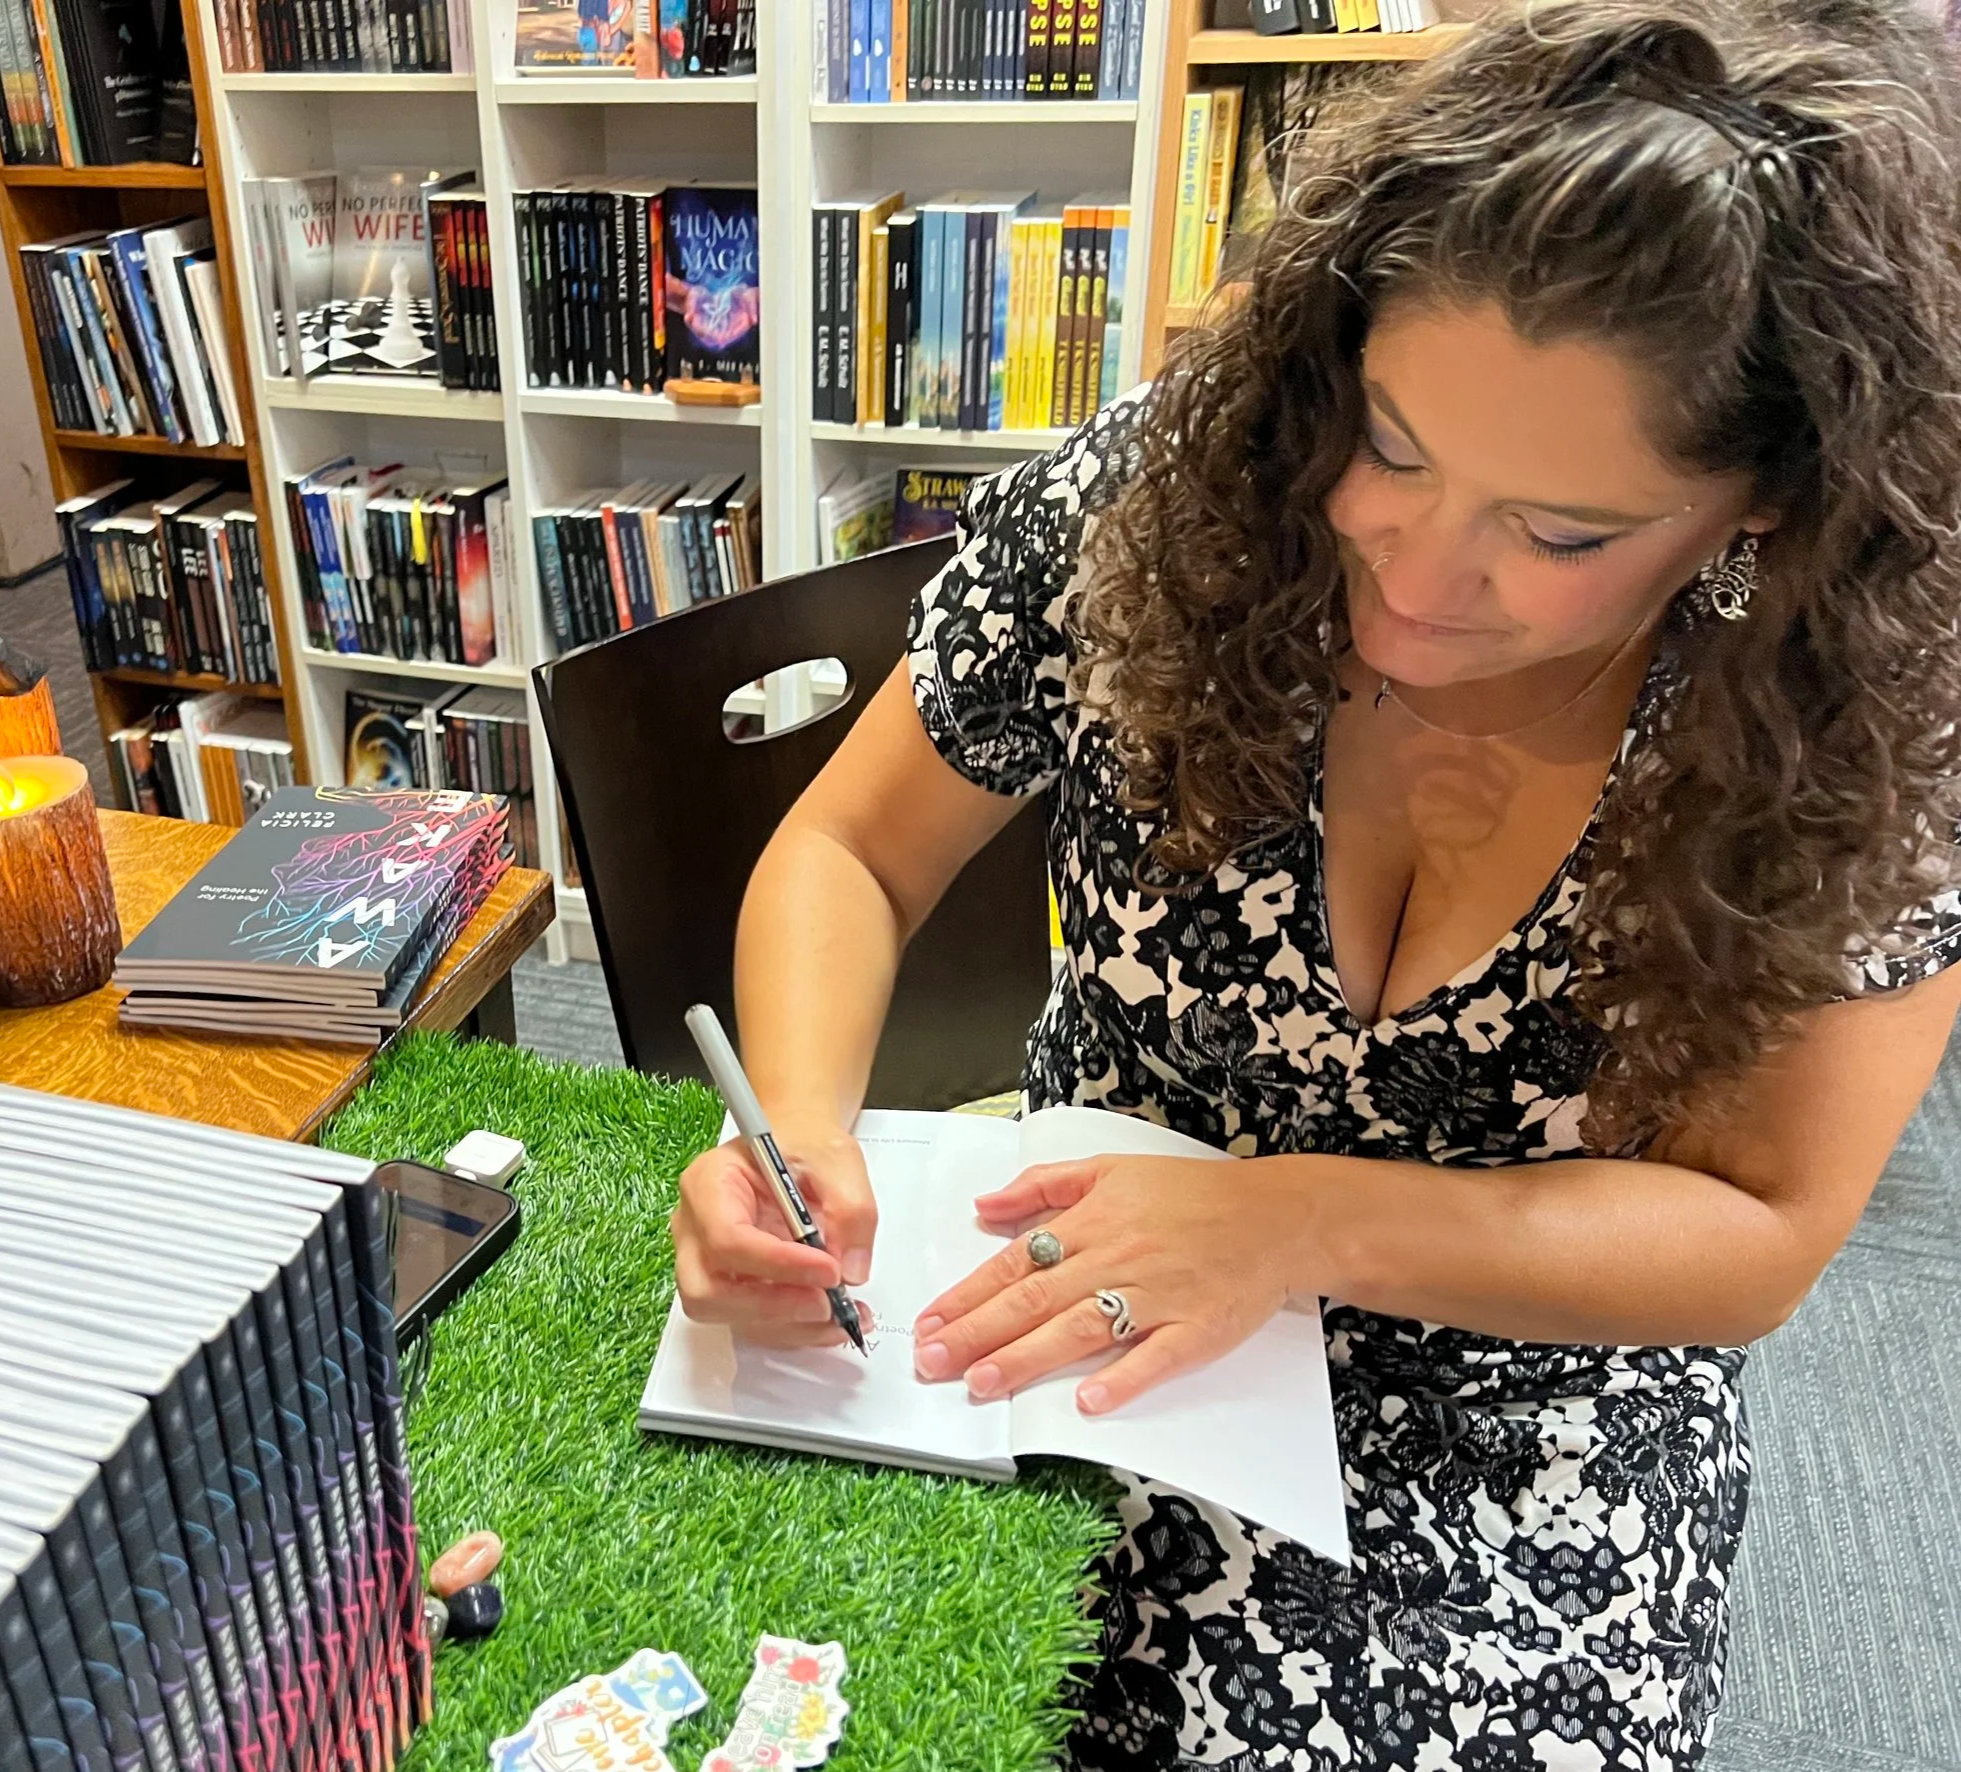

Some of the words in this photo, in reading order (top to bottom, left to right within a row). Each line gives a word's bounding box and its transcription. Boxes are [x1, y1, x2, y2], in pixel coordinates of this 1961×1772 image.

[289, 204, 309, 220] NO
[342, 198, 365, 212] NO
[354, 214, 426, 240] WIFE
[617, 258, 628, 302] DANCE
[637, 263, 649, 305] DANCE
[270, 810, 337, 821] CLARK
[260, 818, 336, 829] FELICIA
[316, 789, 471, 969] AWAKE
[197, 892, 217, 902] for
[199, 885, 248, 895] Healing
[249, 887, 270, 896] the
[219, 892, 261, 903] Poetry
[872, 1323, 914, 1337] Poetry
[585, 1679, 664, 1772] chapter
